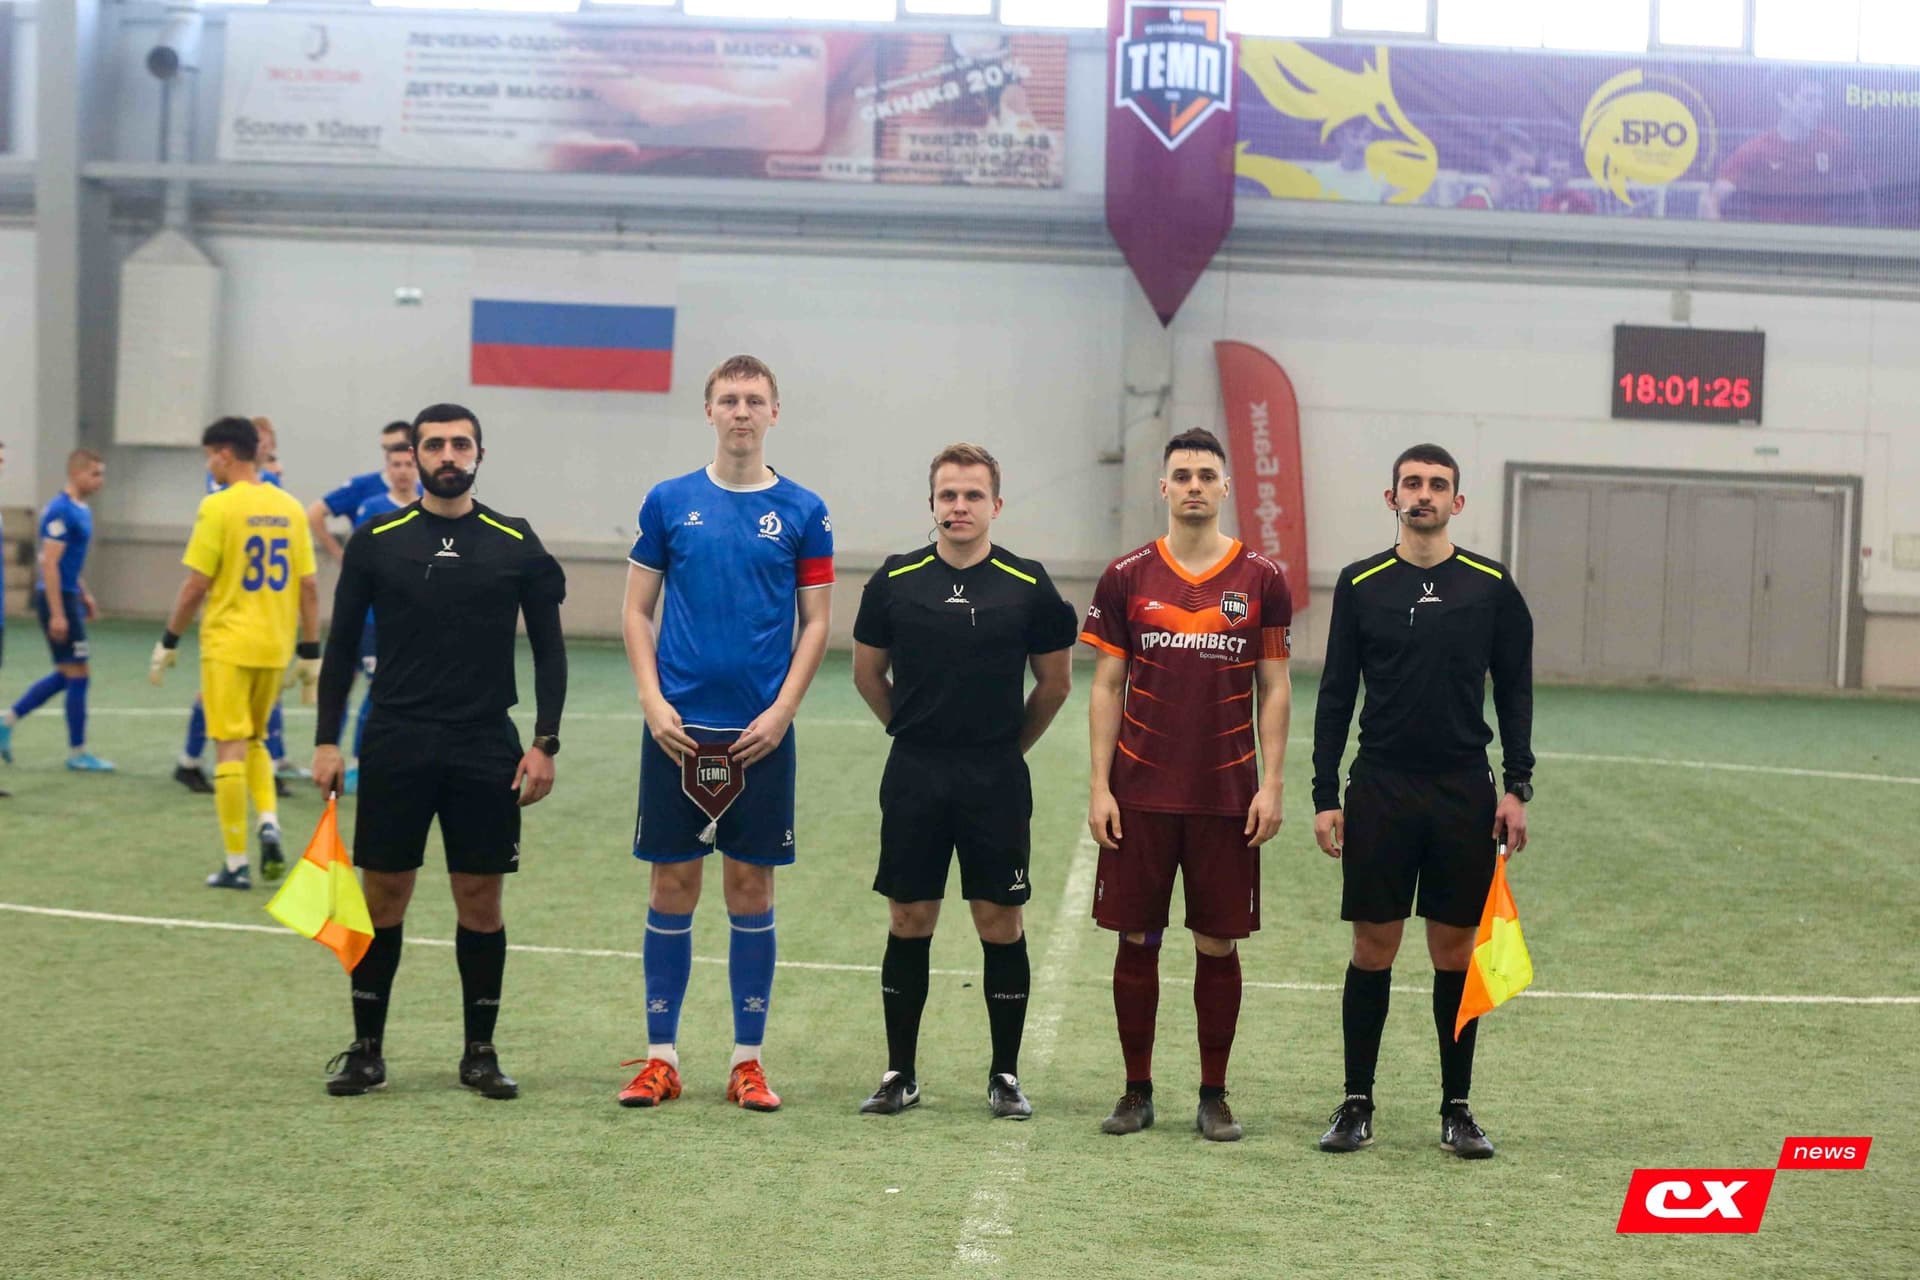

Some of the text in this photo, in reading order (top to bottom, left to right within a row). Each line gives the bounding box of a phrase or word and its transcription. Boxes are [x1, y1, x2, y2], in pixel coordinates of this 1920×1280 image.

[1128, 41, 1220, 95] ТЕМП
[405, 80, 499, 98] ДЕТСКИЙ
[241, 535, 289, 592] 35
[1223, 600, 1246, 617] ТЕМП
[1140, 632, 1247, 654] ПРОДИНВЕСТ
[700, 767, 728, 782] ТЕМП
